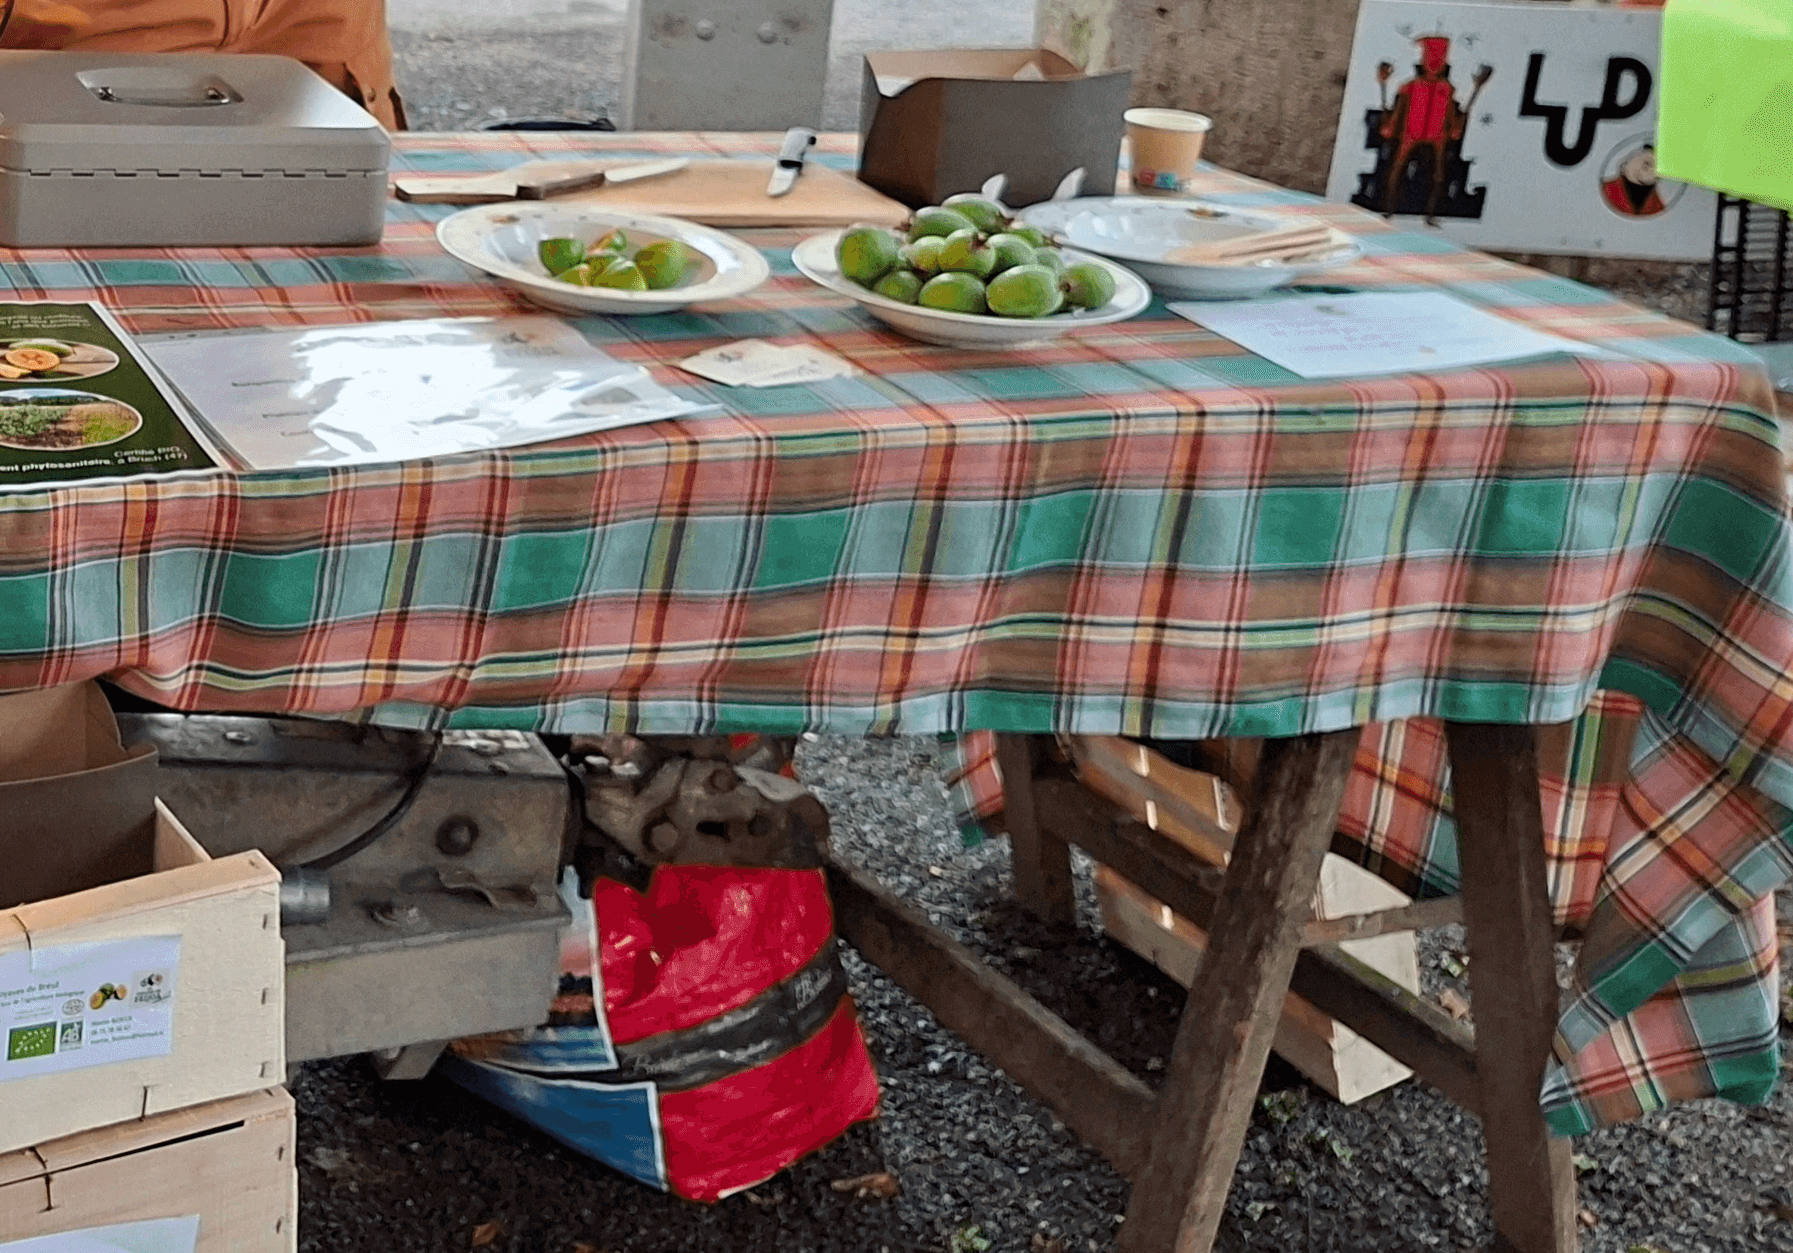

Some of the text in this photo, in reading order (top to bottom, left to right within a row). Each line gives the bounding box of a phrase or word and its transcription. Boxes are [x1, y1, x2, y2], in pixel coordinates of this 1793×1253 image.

[26, 985, 37, 994] du
[38, 980, 60, 992] Brésil
[62, 1021, 82, 1044] AB
